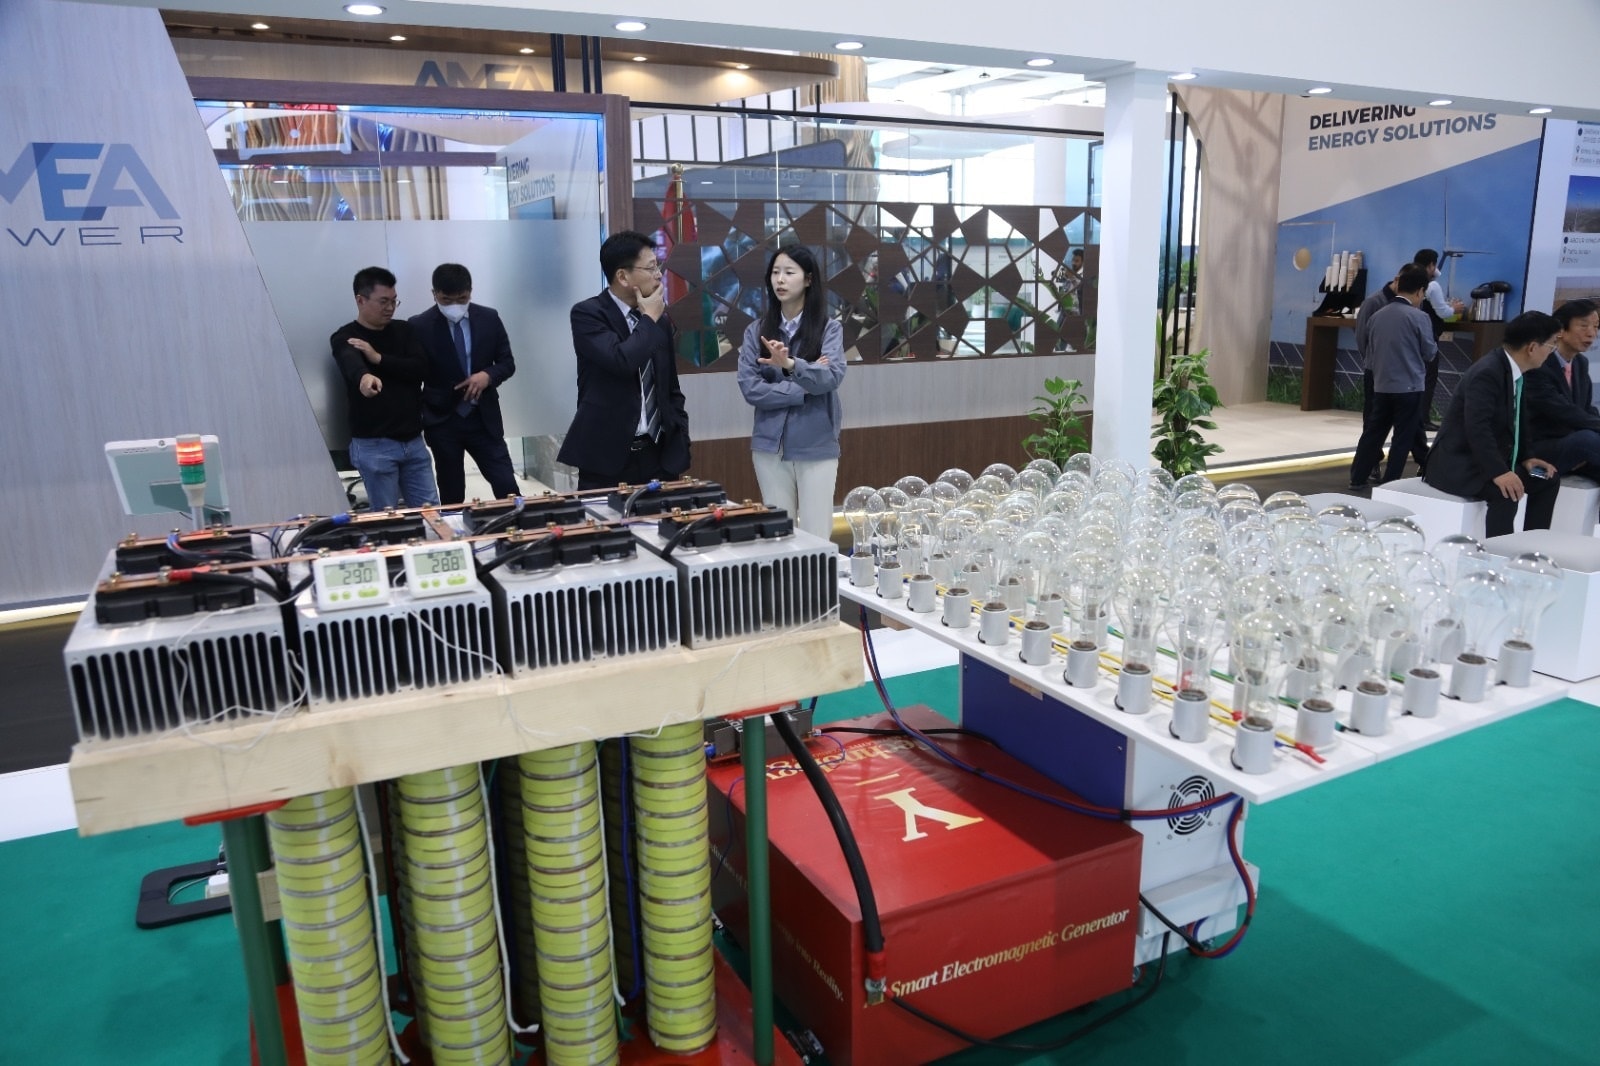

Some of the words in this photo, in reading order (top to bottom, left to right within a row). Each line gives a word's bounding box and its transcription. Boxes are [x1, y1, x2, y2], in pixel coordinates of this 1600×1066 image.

[1308, 128, 1379, 151] ENERGY
[1382, 112, 1497, 142] SOLUTIONS
[875, 788, 984, 842] Y
[891, 973, 938, 998] Smart
[941, 931, 1058, 982] Electromagnetic
[1061, 909, 1130, 942] Generator
